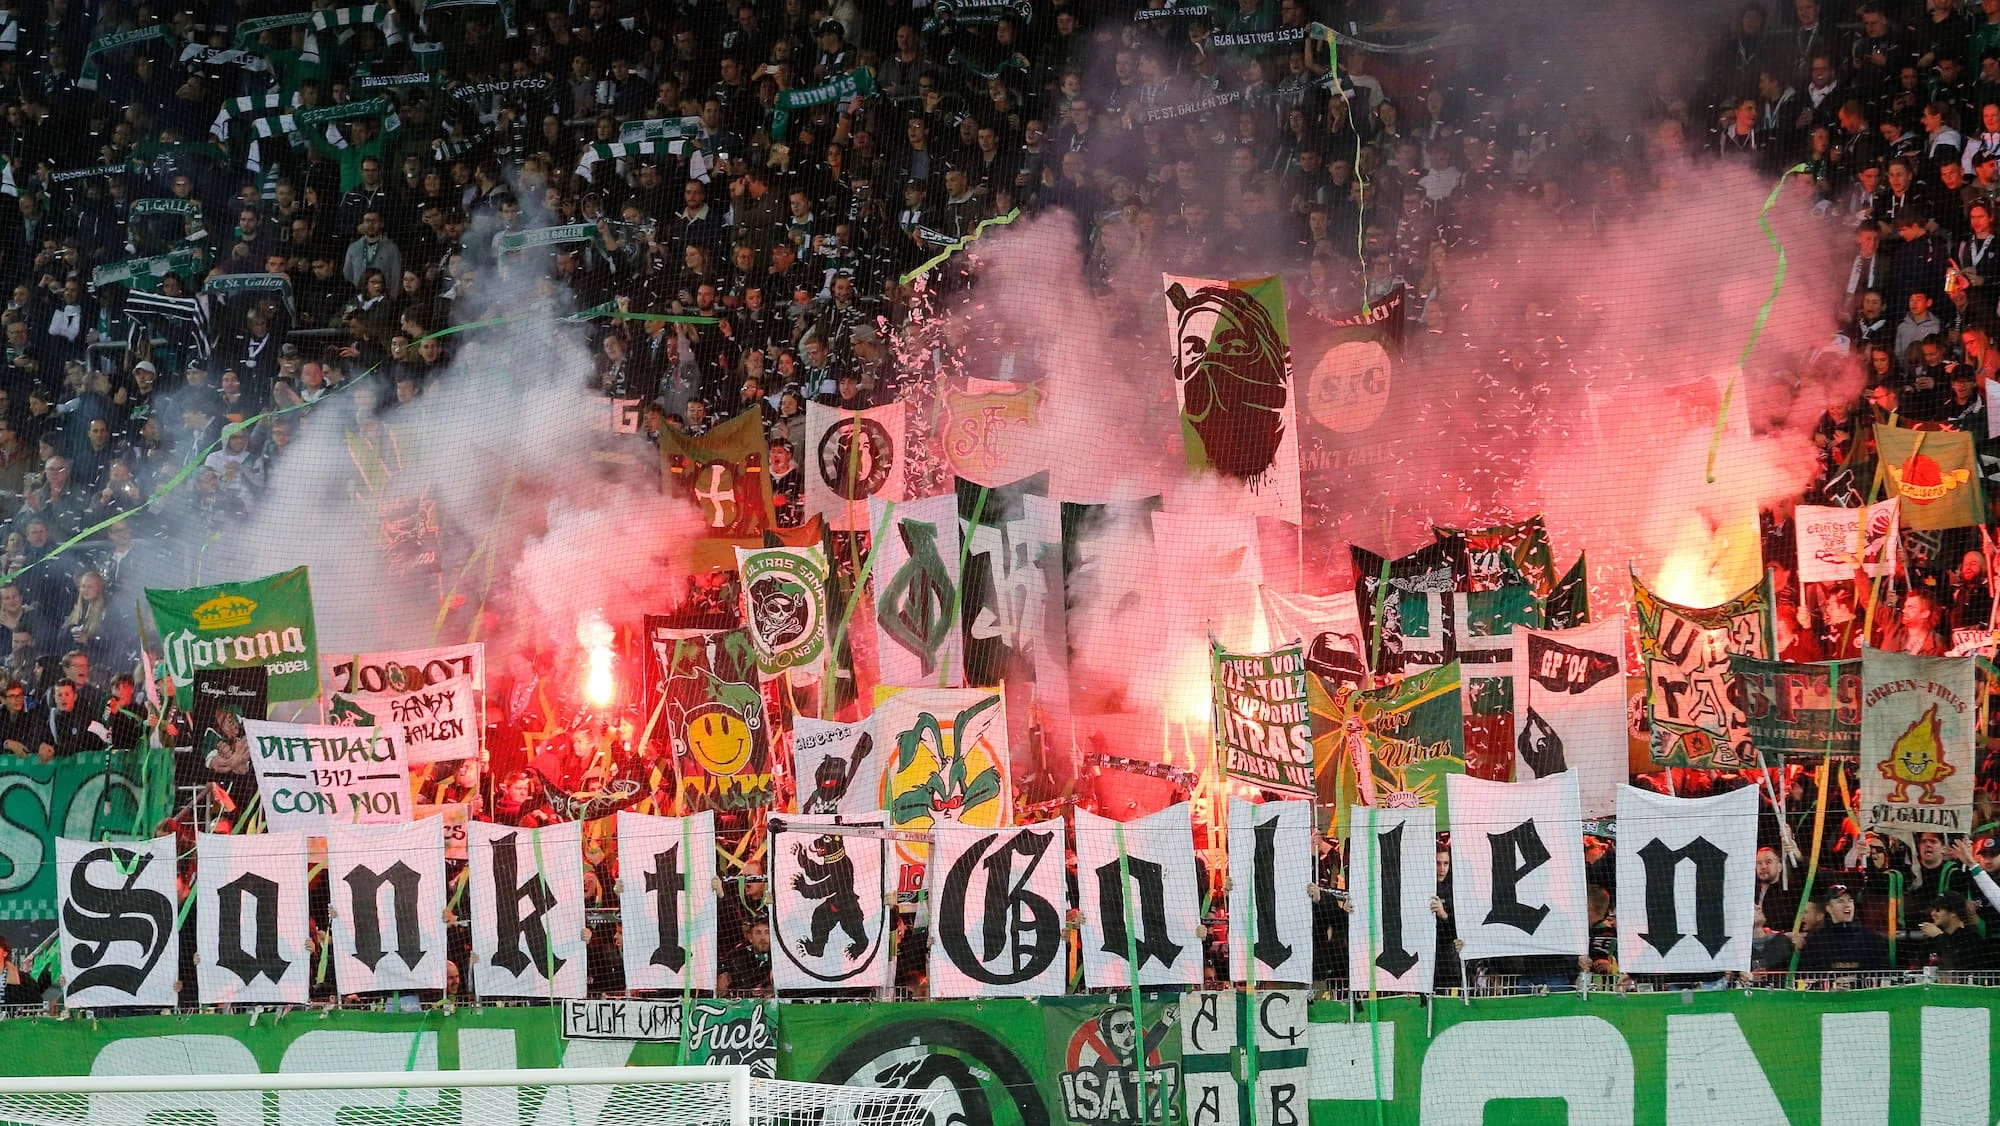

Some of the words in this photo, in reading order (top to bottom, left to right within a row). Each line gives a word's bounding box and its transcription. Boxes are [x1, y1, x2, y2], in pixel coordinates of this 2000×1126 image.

[1213, 34, 1236, 47] 1879
[1236, 31, 1274, 45] GALLEN
[1291, 27, 1304, 39] FC
[453, 84, 476, 99] WIR
[478, 80, 510, 93] SIND
[513, 78, 547, 90] FCSG
[1147, 109, 1161, 122] FC
[1178, 98, 1216, 117] GALLEN
[205, 279, 221, 291] FC
[244, 277, 284, 288] Gallen
[746, 557, 795, 577] ULTRAS
[164, 626, 307, 687] Corona
[1271, 652, 1305, 675] VON
[1377, 735, 1452, 768] Ultras
[310, 769, 356, 787] 1312
[1283, 765, 1315, 789] NIE
[272, 787, 338, 815] CON
[347, 791, 401, 815] NOI
[1869, 804, 1961, 830] ST.GALLEN
[62, 831, 690, 998] Sankt
[938, 815, 1729, 985] Gallen
[572, 1002, 626, 1034] FUCK
[638, 1004, 683, 1036] VAR
[689, 1004, 770, 1050] Fuck
[1270, 1083, 1299, 1126] B
